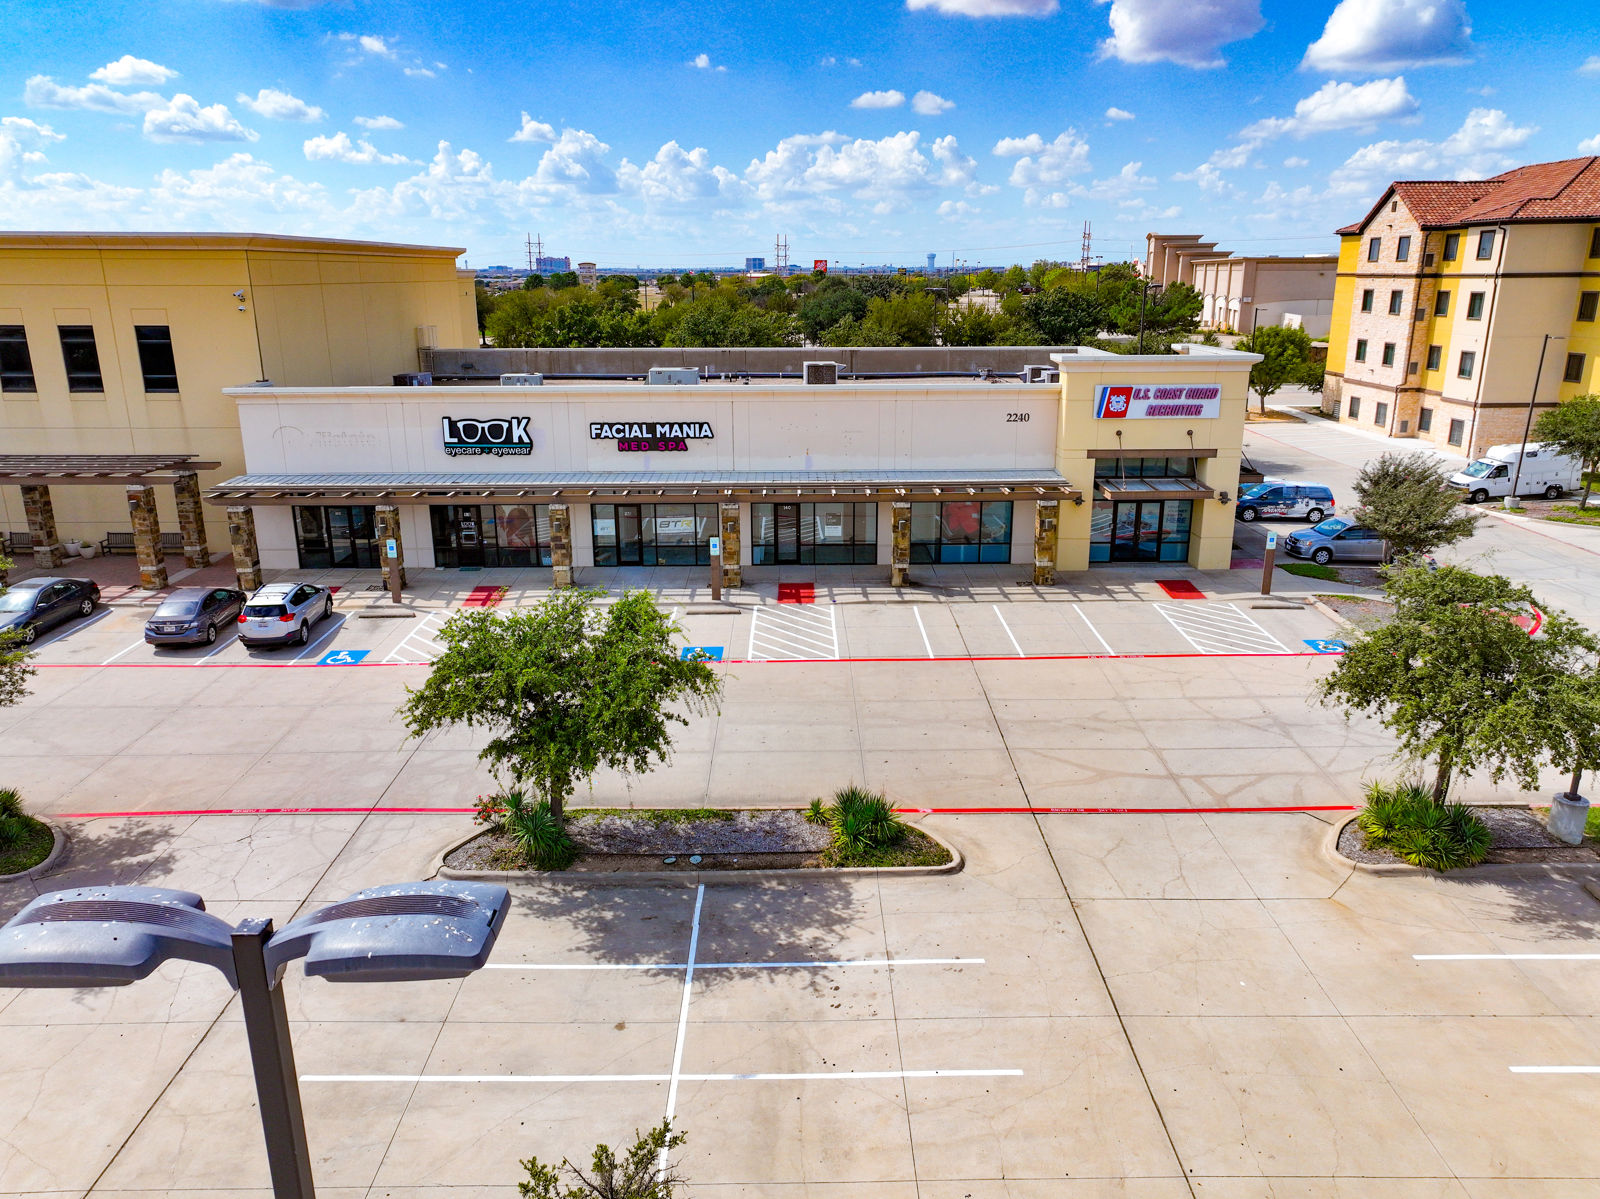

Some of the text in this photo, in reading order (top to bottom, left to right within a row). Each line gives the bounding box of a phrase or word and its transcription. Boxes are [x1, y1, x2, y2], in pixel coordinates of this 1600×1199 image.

[1133, 387, 1220, 400] U.S. COAST GUARD
[1145, 404, 1204, 417] RECRUITING
[1006, 413, 1030, 423] 2240
[442, 418, 531, 443] LOOK
[590, 423, 713, 439] FACIAL MANIA
[445, 447, 481, 455] eyecare
[491, 447, 531, 455] eyewear
[618, 441, 688, 451] MED SPA
[660, 519, 692, 528] BTR
